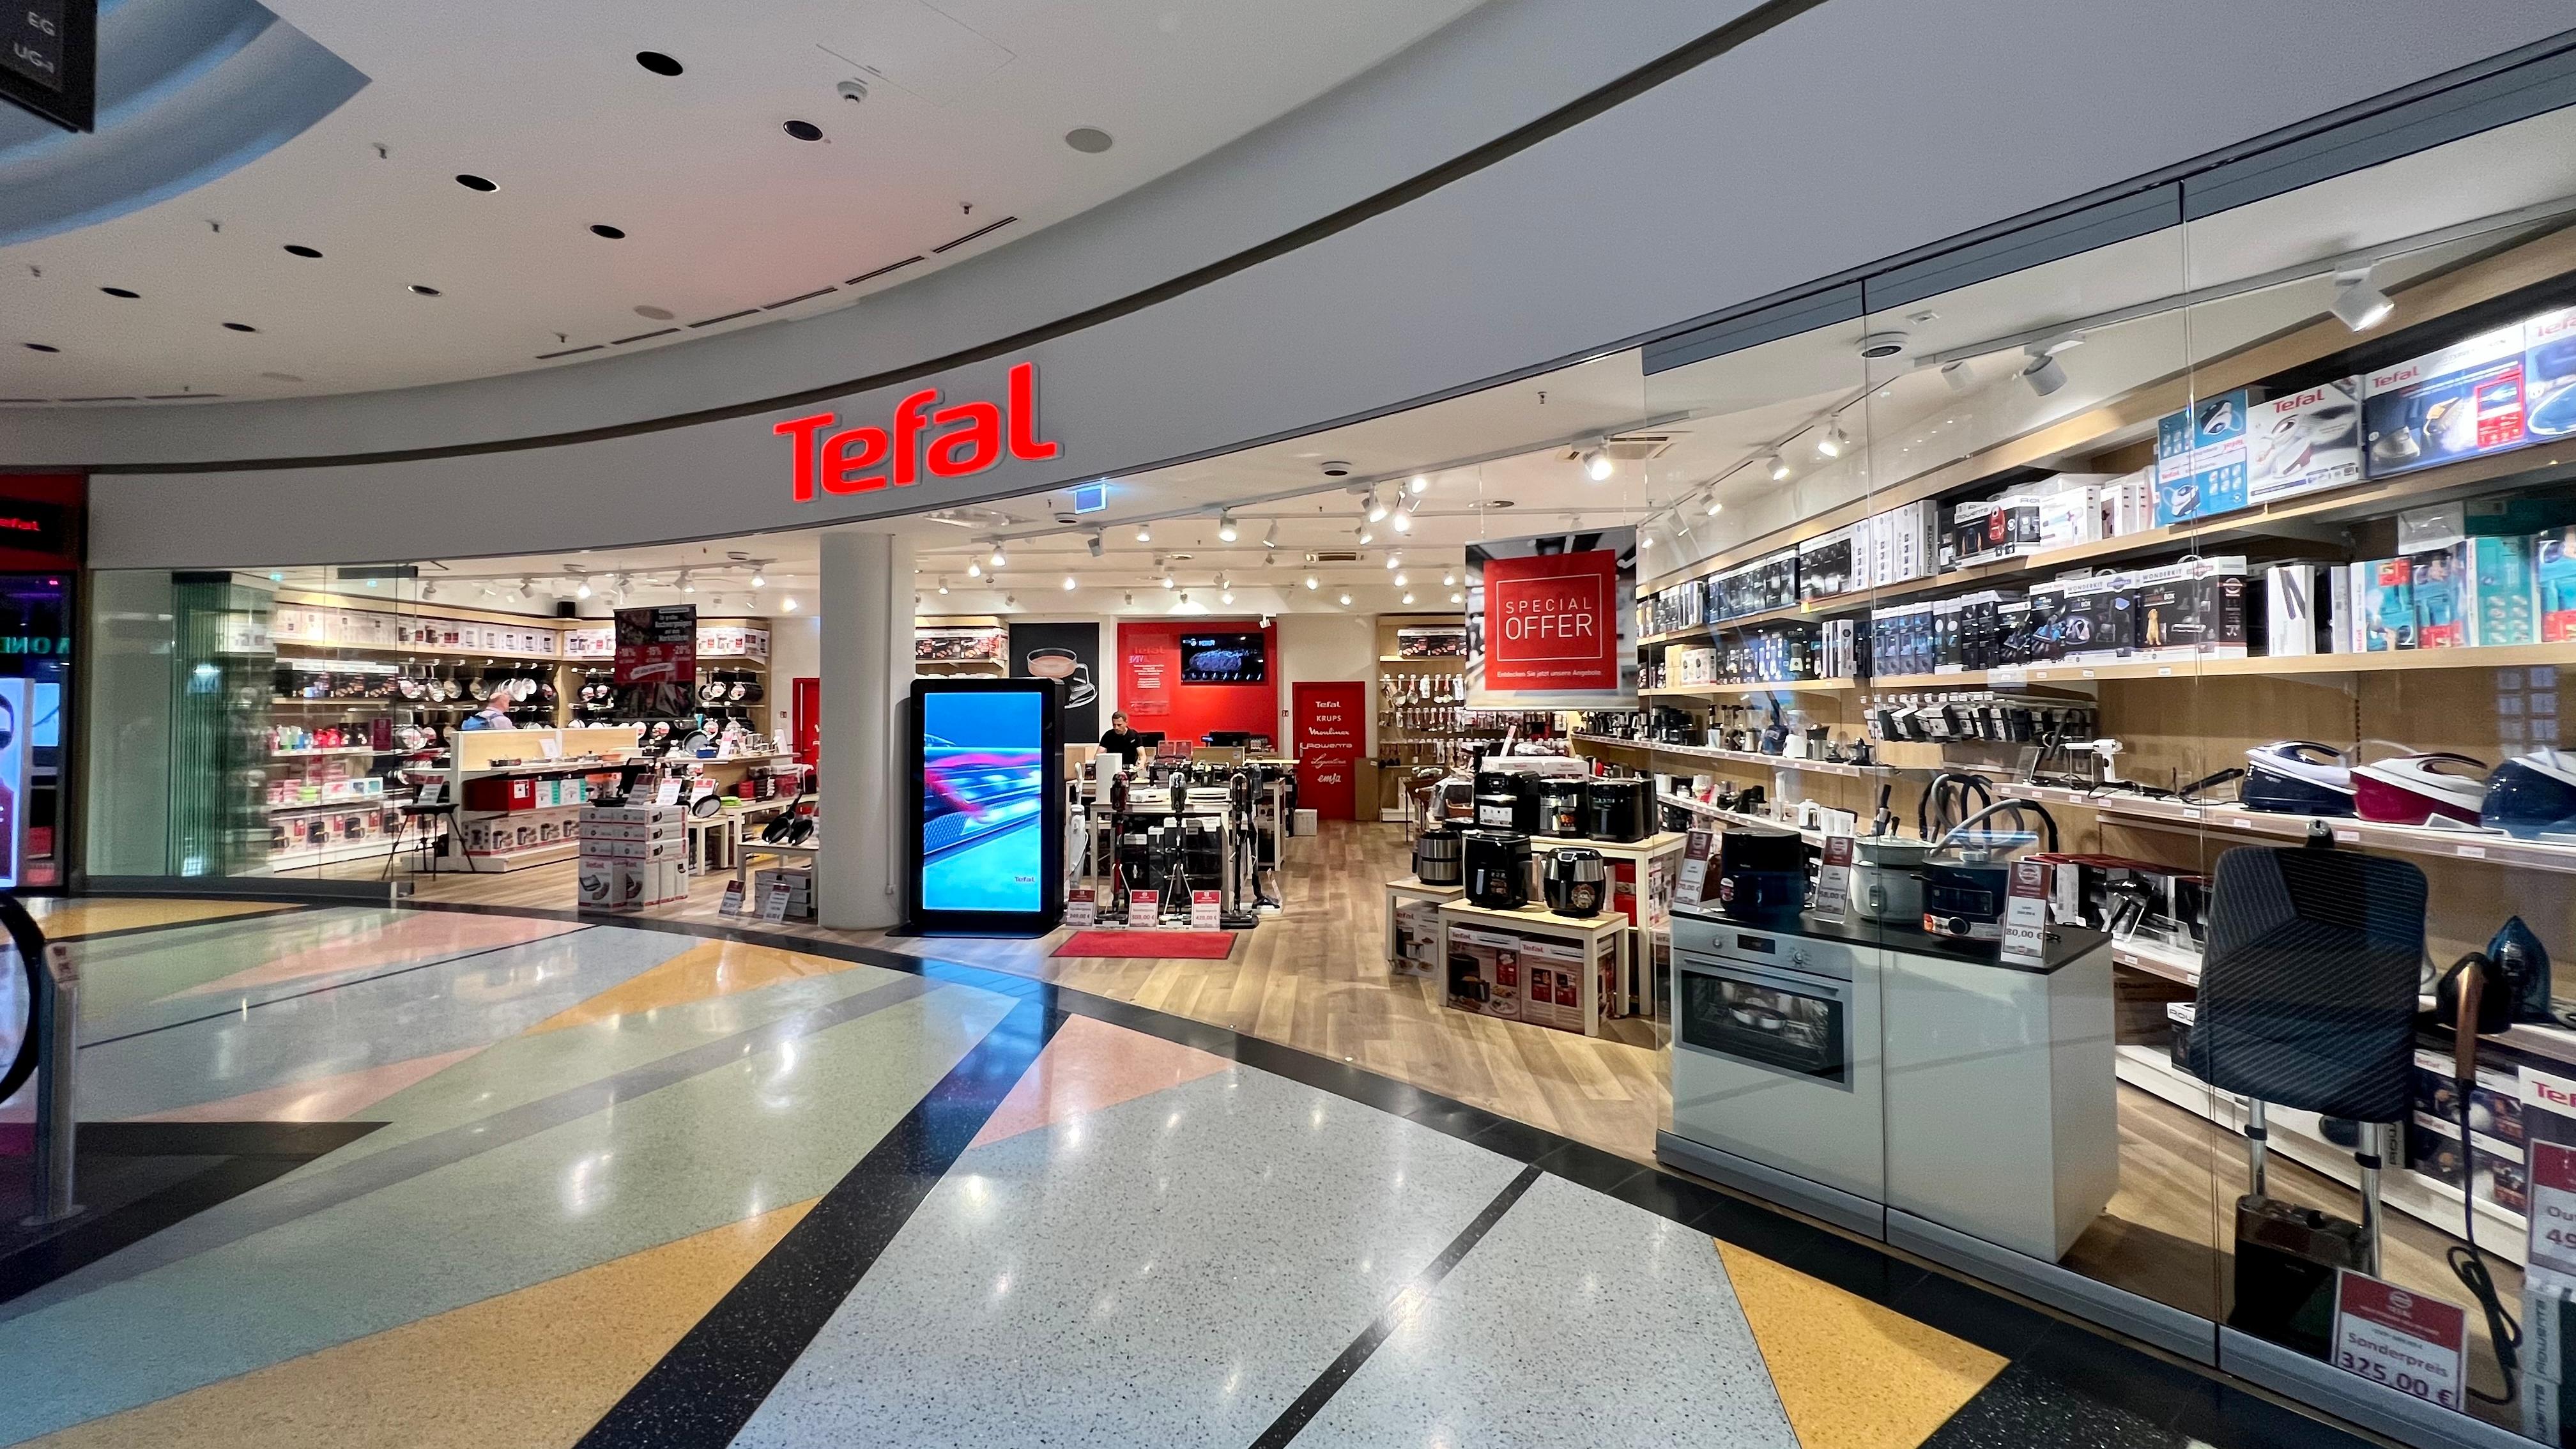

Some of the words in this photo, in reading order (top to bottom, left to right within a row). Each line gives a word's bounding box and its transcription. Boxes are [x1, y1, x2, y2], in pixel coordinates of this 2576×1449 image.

[27, 11, 56, 36] EG
[2372, 365, 2419, 388] Tefal
[2272, 388, 2325, 413] Tefal
[773, 362, 1057, 502] Tefal
[2143, 569, 2182, 580] WONDERKIT
[2067, 582, 2103, 592] WONDERKIT
[1505, 597, 1592, 614] SPECIAL
[1505, 613, 1592, 640] OFFER
[1308, 726, 1349, 735] Moulinex
[1522, 944, 1544, 953] Tefal
[2348, 1332, 2449, 1377] Sonderpreis
[2437, 1388, 2454, 1407] €
